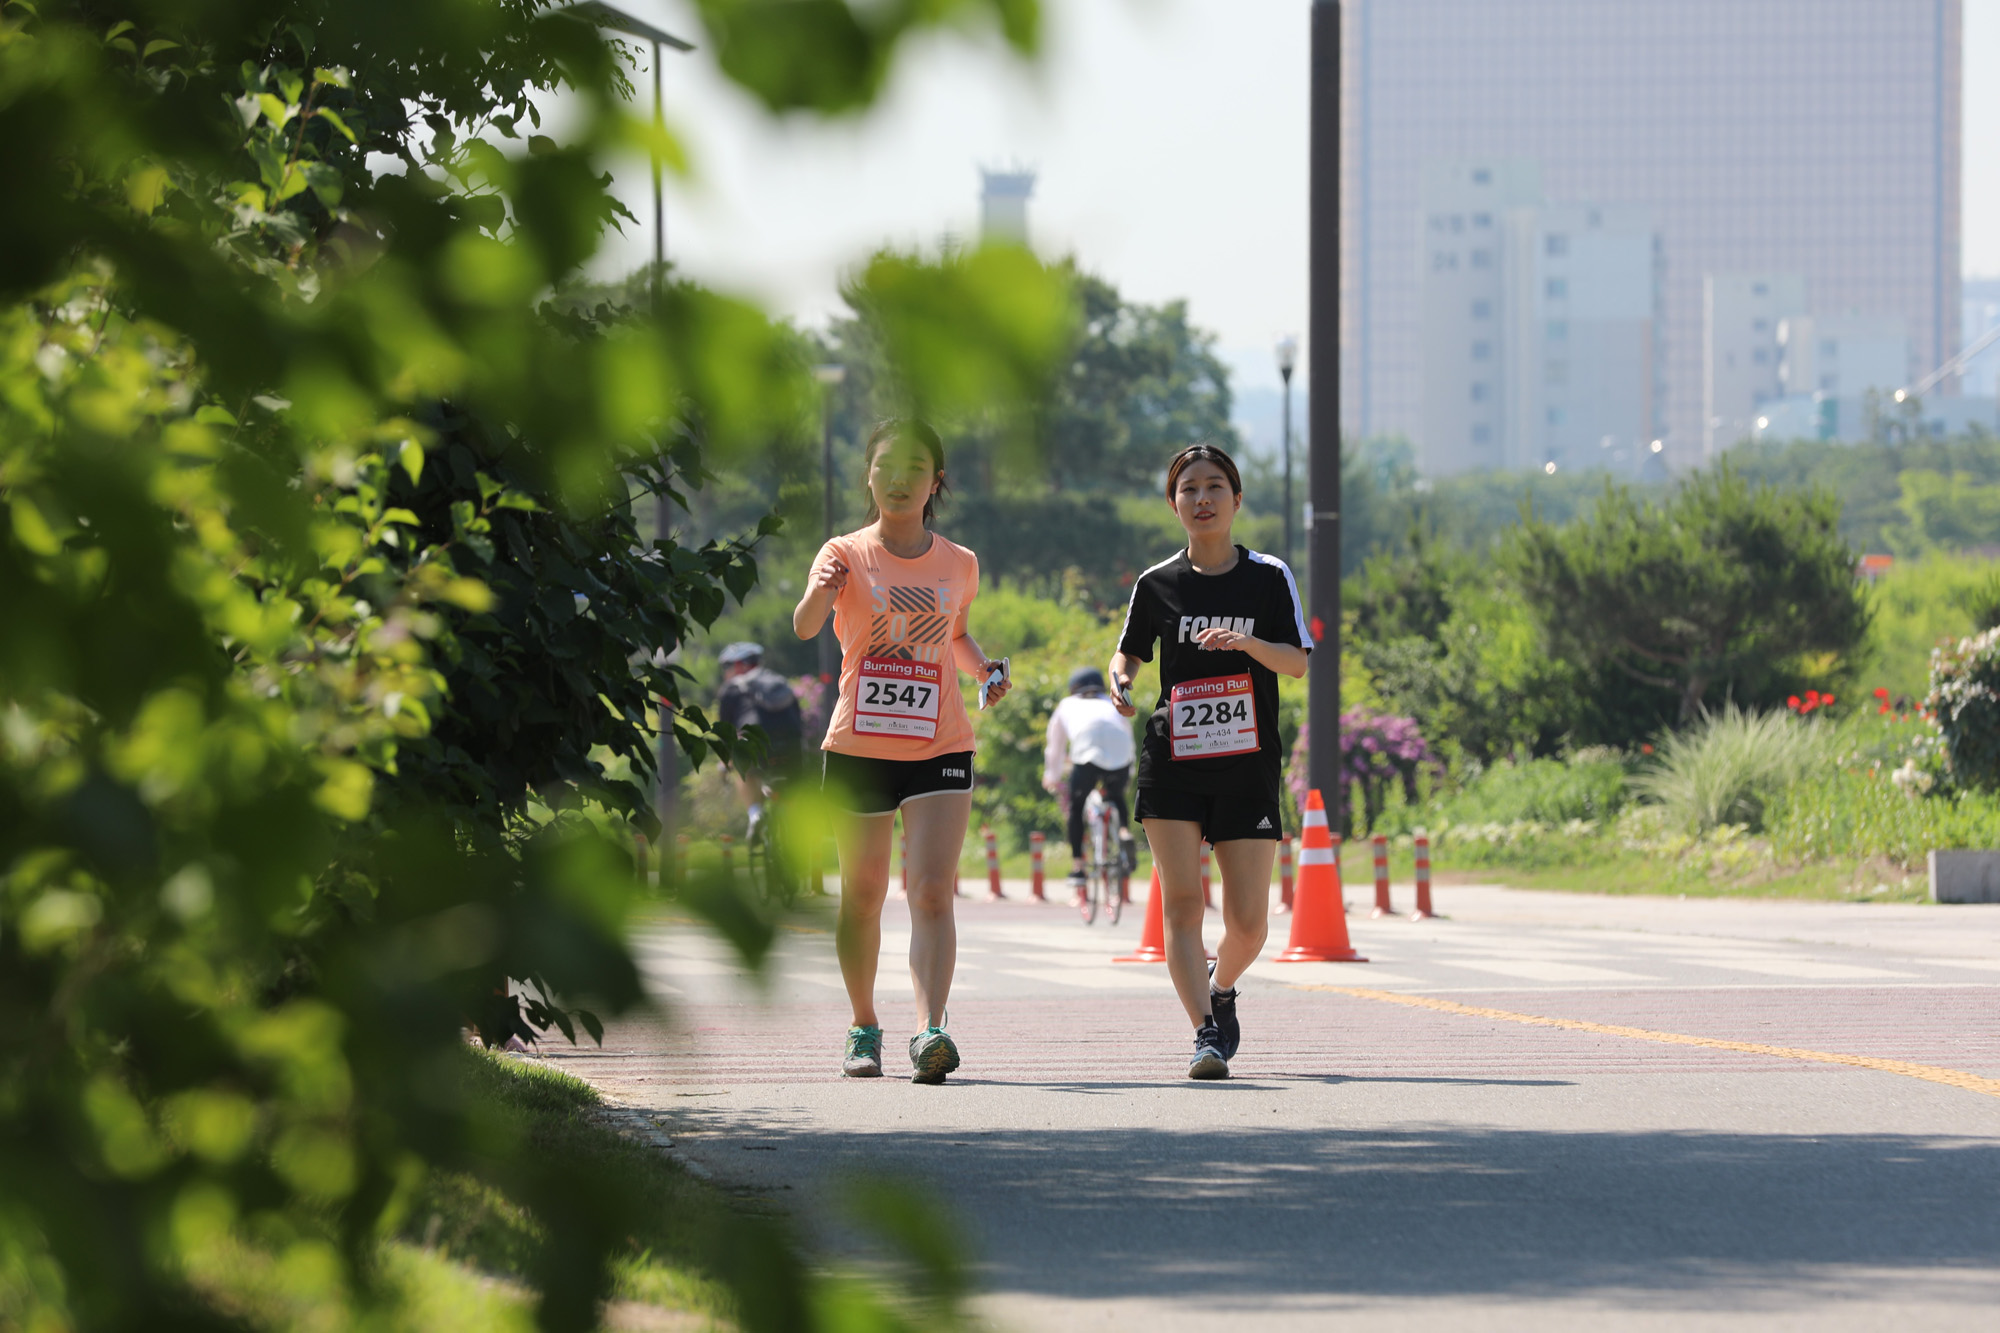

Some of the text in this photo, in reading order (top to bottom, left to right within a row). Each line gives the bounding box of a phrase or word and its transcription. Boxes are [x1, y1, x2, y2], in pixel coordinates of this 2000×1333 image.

[871, 585, 952, 614] S E
[863, 661, 913, 676] Burning
[915, 665, 937, 677] Run
[865, 682, 932, 709] 2547
[1176, 682, 1224, 696] Burning
[1227, 679, 1248, 690] Run
[1181, 699, 1247, 728] 2284
[1205, 728, 1231, 739] A-434
[942, 768, 965, 779] FCMM
